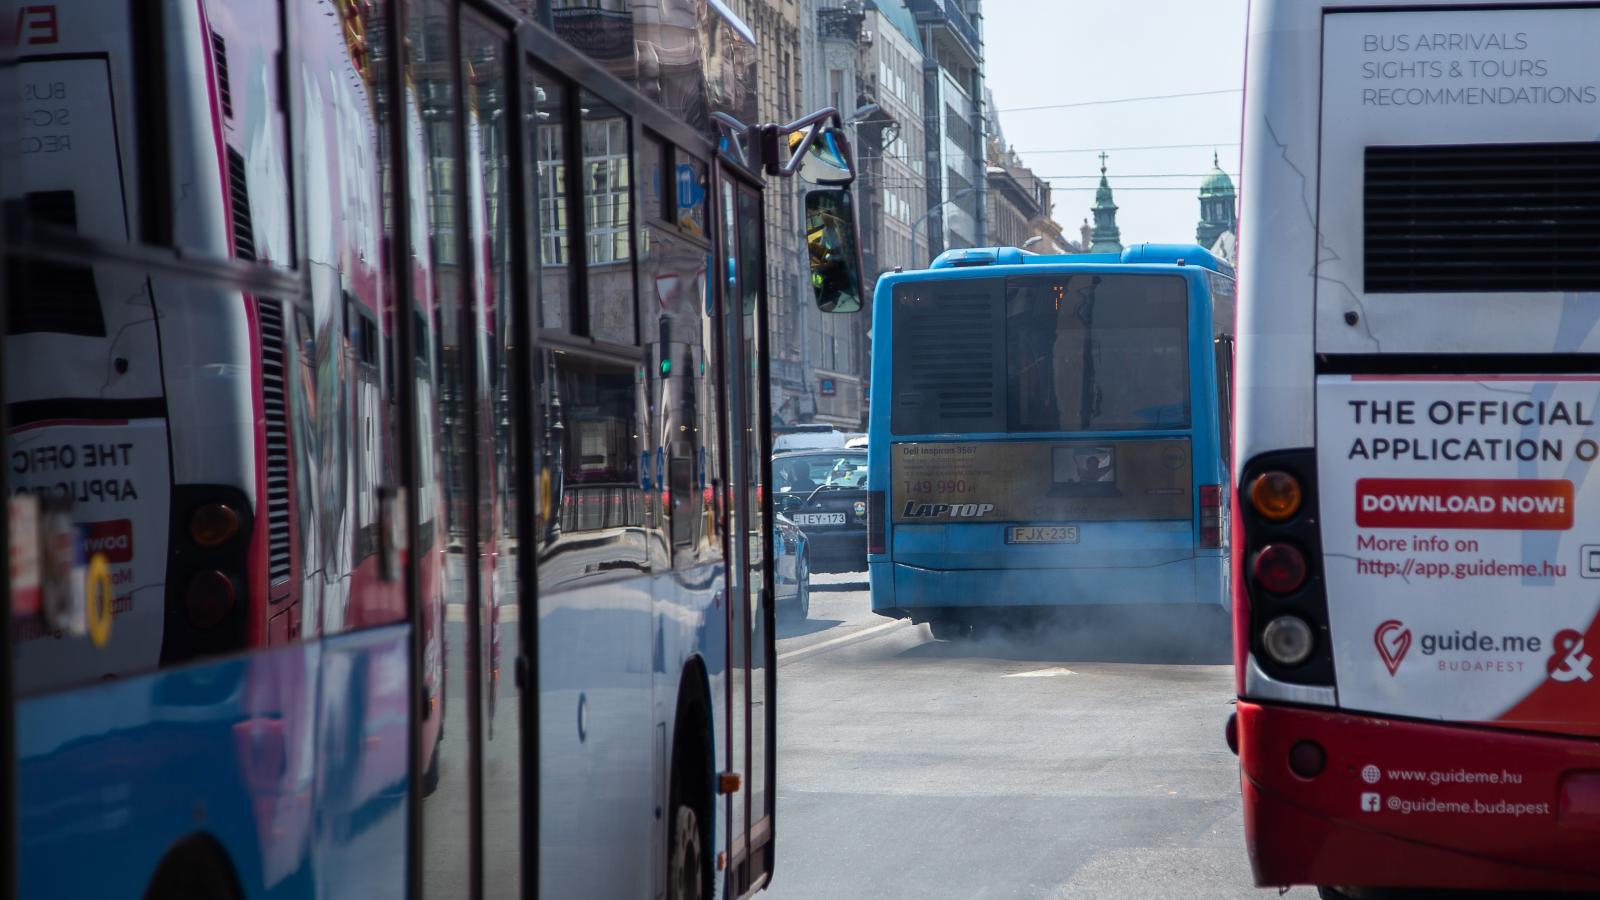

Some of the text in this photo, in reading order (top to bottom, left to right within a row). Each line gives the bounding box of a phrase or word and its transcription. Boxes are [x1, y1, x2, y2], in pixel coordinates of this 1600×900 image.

[1363, 32, 1528, 52] BUS ARRIVALS
[1361, 59, 1548, 79] SIGHTS & TOURS
[1361, 86, 1598, 106] RECOMMENDATIONS
[1348, 400, 1594, 425] THE OFFICIAL
[1348, 438, 1563, 462] APPLICATION
[903, 480, 932, 494] 149
[937, 480, 966, 494] 990
[903, 500, 994, 518] LAPTOP
[1361, 495, 1565, 513] DOWNLOAD NOW!
[803, 513, 845, 524] IEY-173
[1015, 528, 1077, 541] FJX-235
[1357, 534, 1479, 552] More info on
[1357, 558, 1567, 580] http://app.guideme.hu
[1421, 630, 1542, 655] guide.me
[1438, 661, 1525, 672] BUDAPEST
[1388, 769, 1523, 785] www.guideme.hu
[1387, 796, 1550, 817] @guideme.budapest
